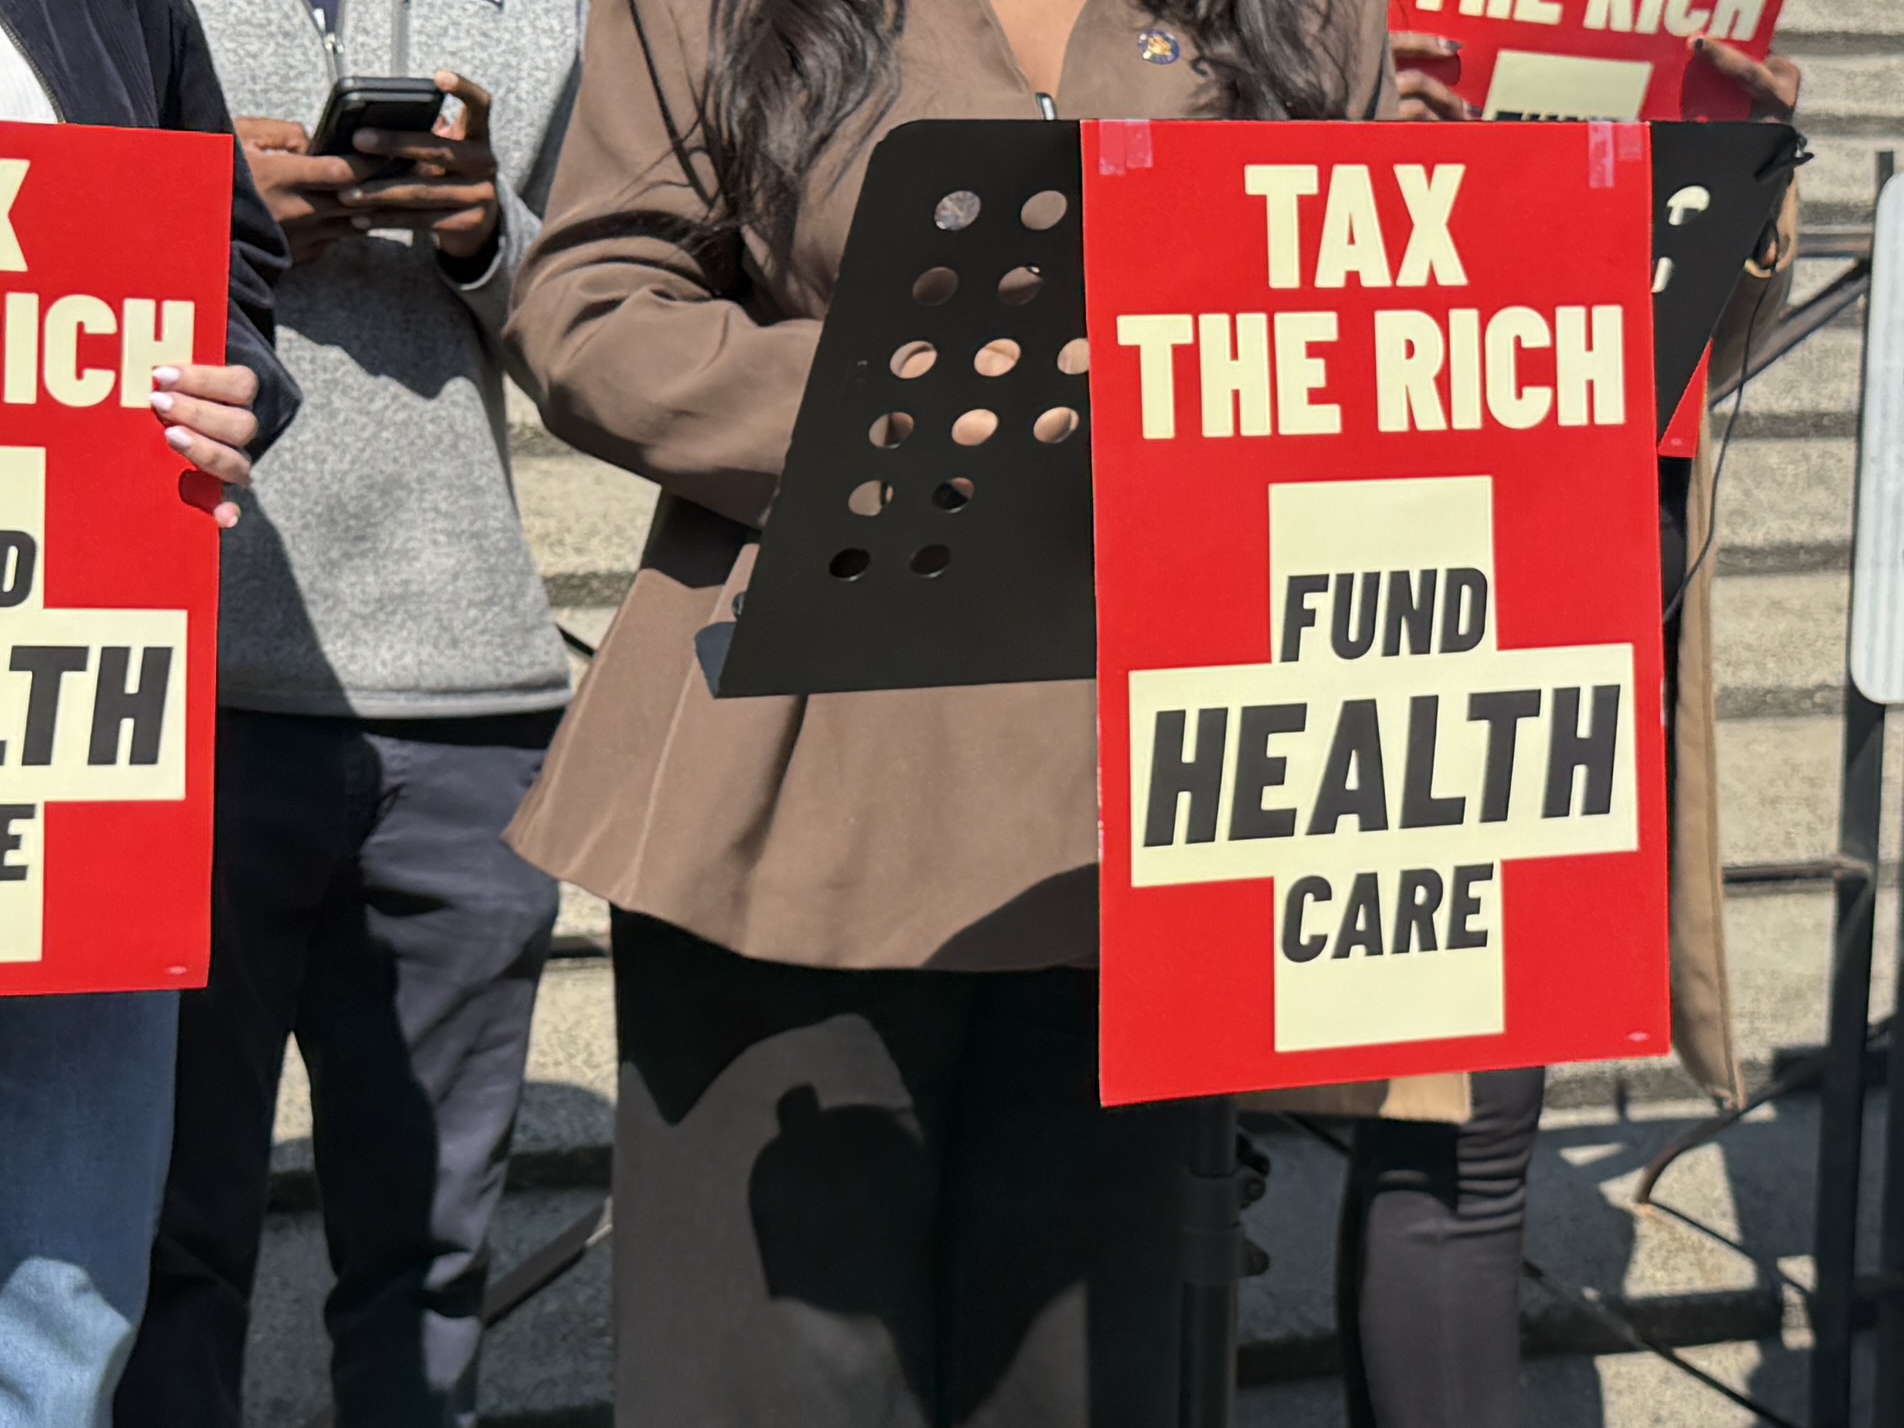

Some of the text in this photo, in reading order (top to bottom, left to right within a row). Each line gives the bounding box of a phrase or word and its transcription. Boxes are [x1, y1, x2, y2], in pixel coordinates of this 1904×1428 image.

[1244, 163, 1467, 290] TAX
[1116, 304, 1625, 440] THE RICH
[1280, 566, 1488, 663] FUND
[1142, 683, 1621, 848] HEALTH
[1280, 862, 1494, 963] CARE
